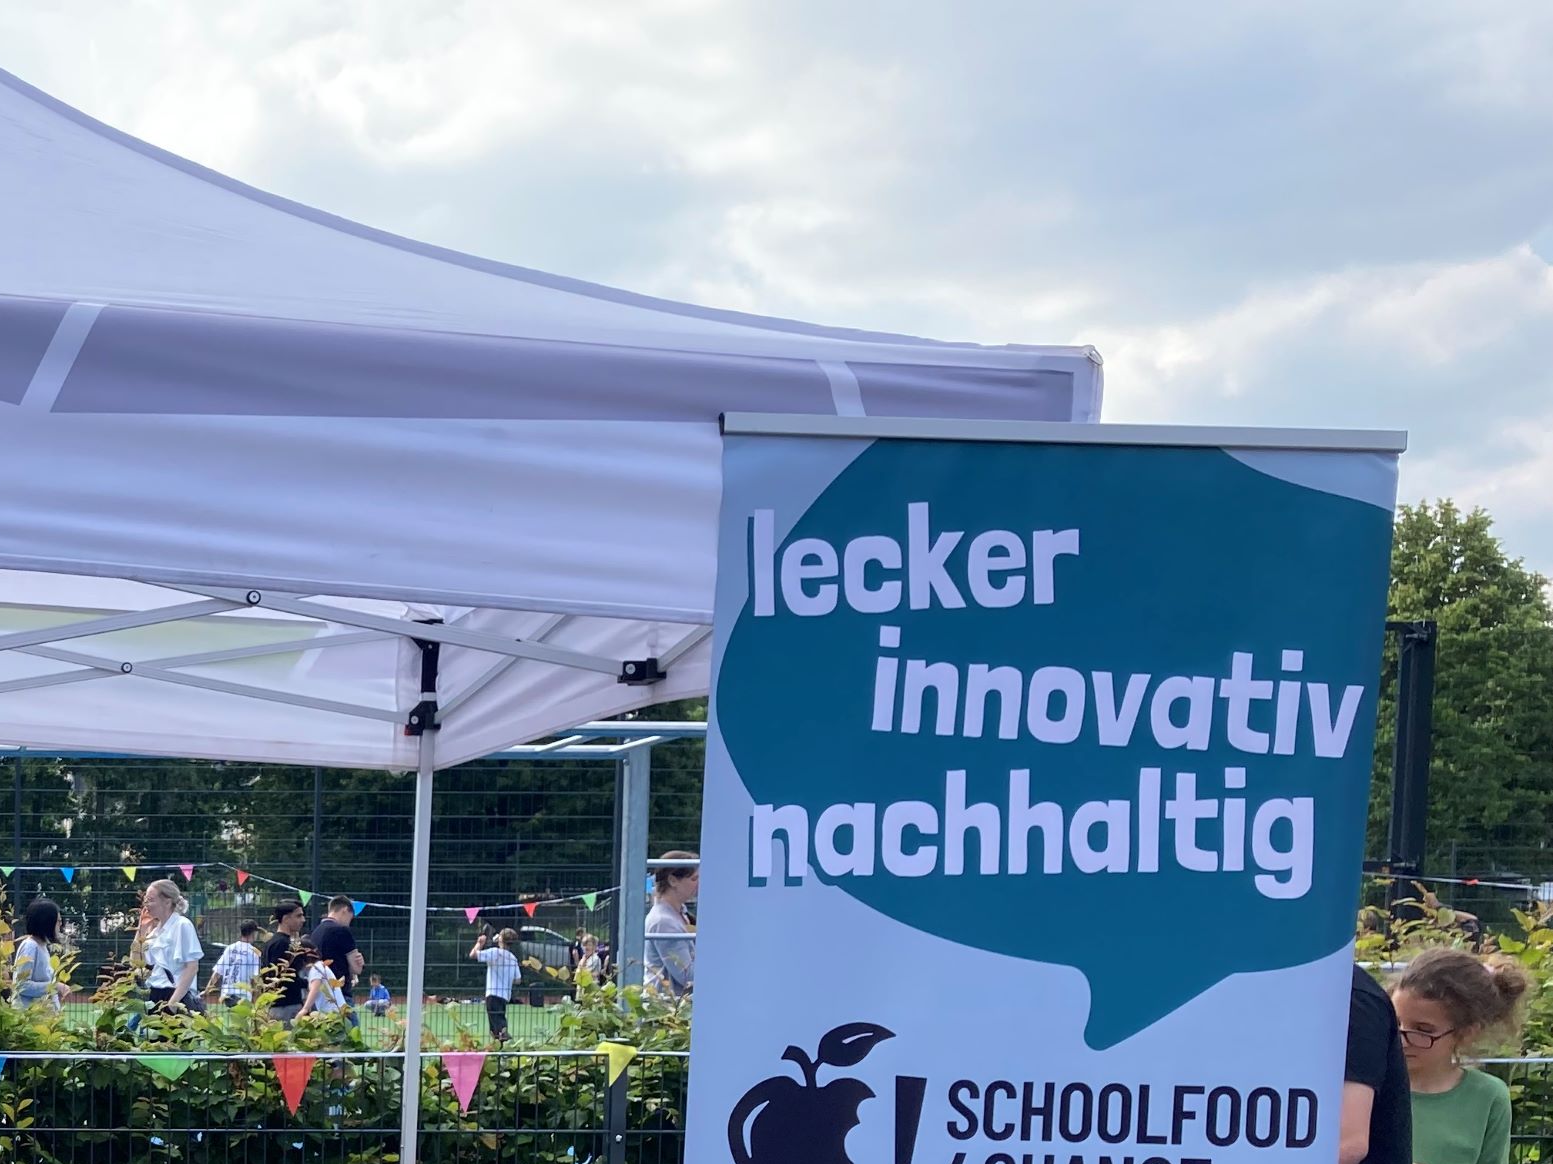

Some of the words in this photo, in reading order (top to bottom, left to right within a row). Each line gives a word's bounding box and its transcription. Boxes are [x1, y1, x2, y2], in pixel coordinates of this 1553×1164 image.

[752, 502, 1080, 617] lecker
[870, 625, 1365, 760] innovativ
[750, 767, 1315, 900] nachhaltig
[946, 1079, 1319, 1149] SCHOOLFOOD
